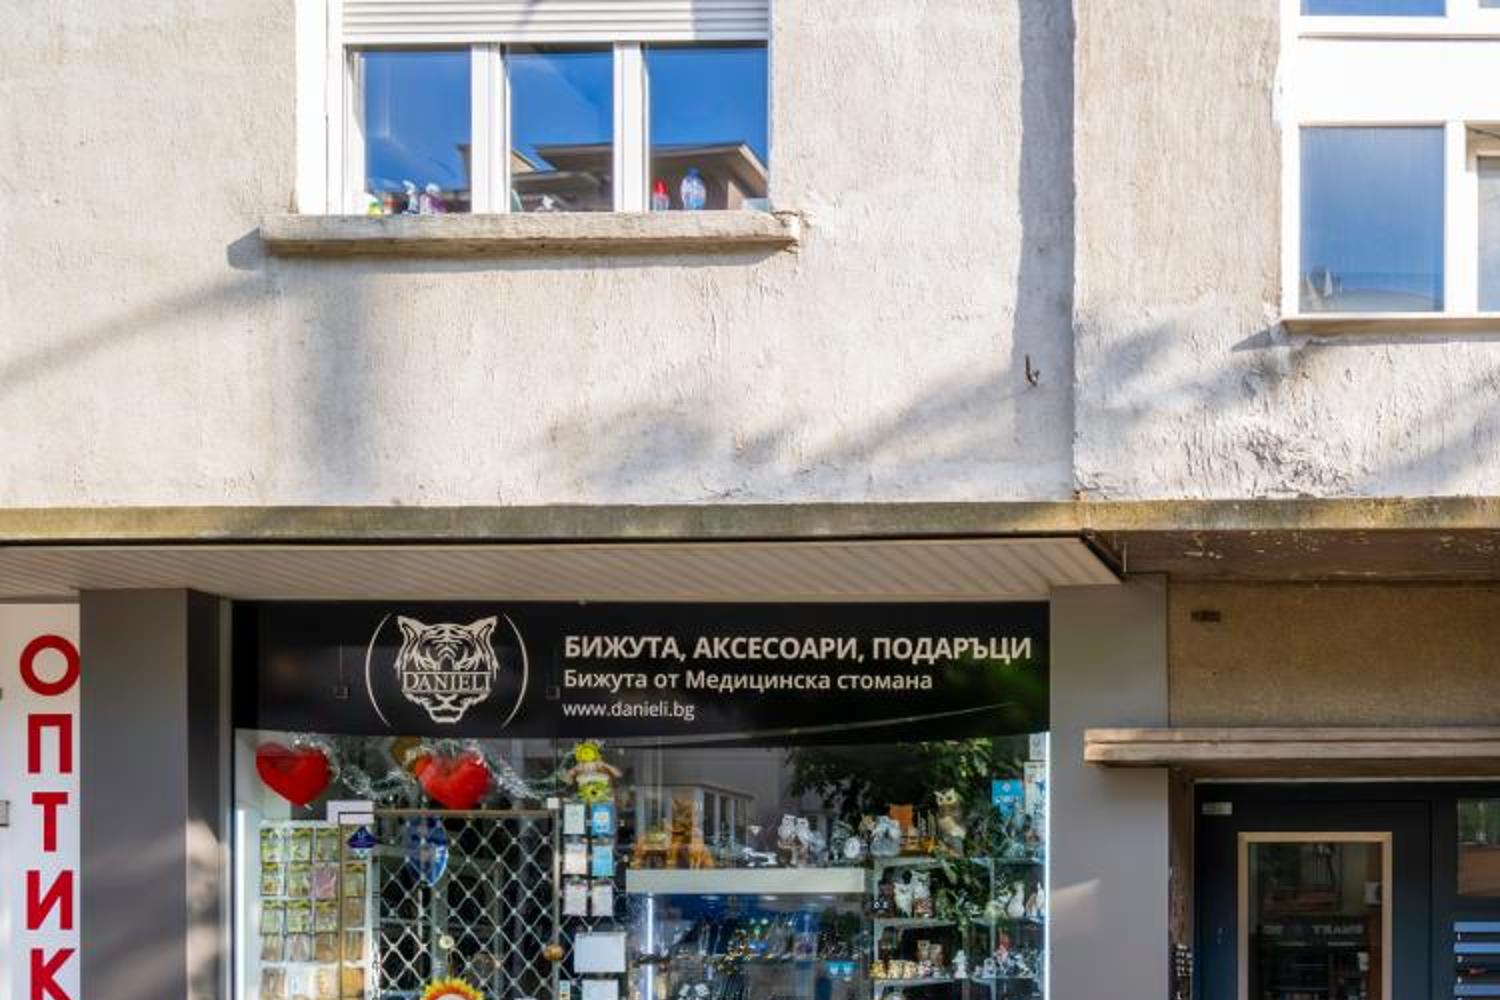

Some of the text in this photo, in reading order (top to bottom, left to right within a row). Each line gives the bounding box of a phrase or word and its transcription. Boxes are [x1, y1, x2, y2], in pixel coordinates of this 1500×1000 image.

[565, 635, 1032, 665] БИЖУТА, АКСЕСОАРИ, ПОДАРЪЦИ
[402, 672, 490, 693] DANIELI
[564, 669, 932, 693] Бижута от Медицинска стомана
[562, 701, 695, 721] www.danieli.bg
